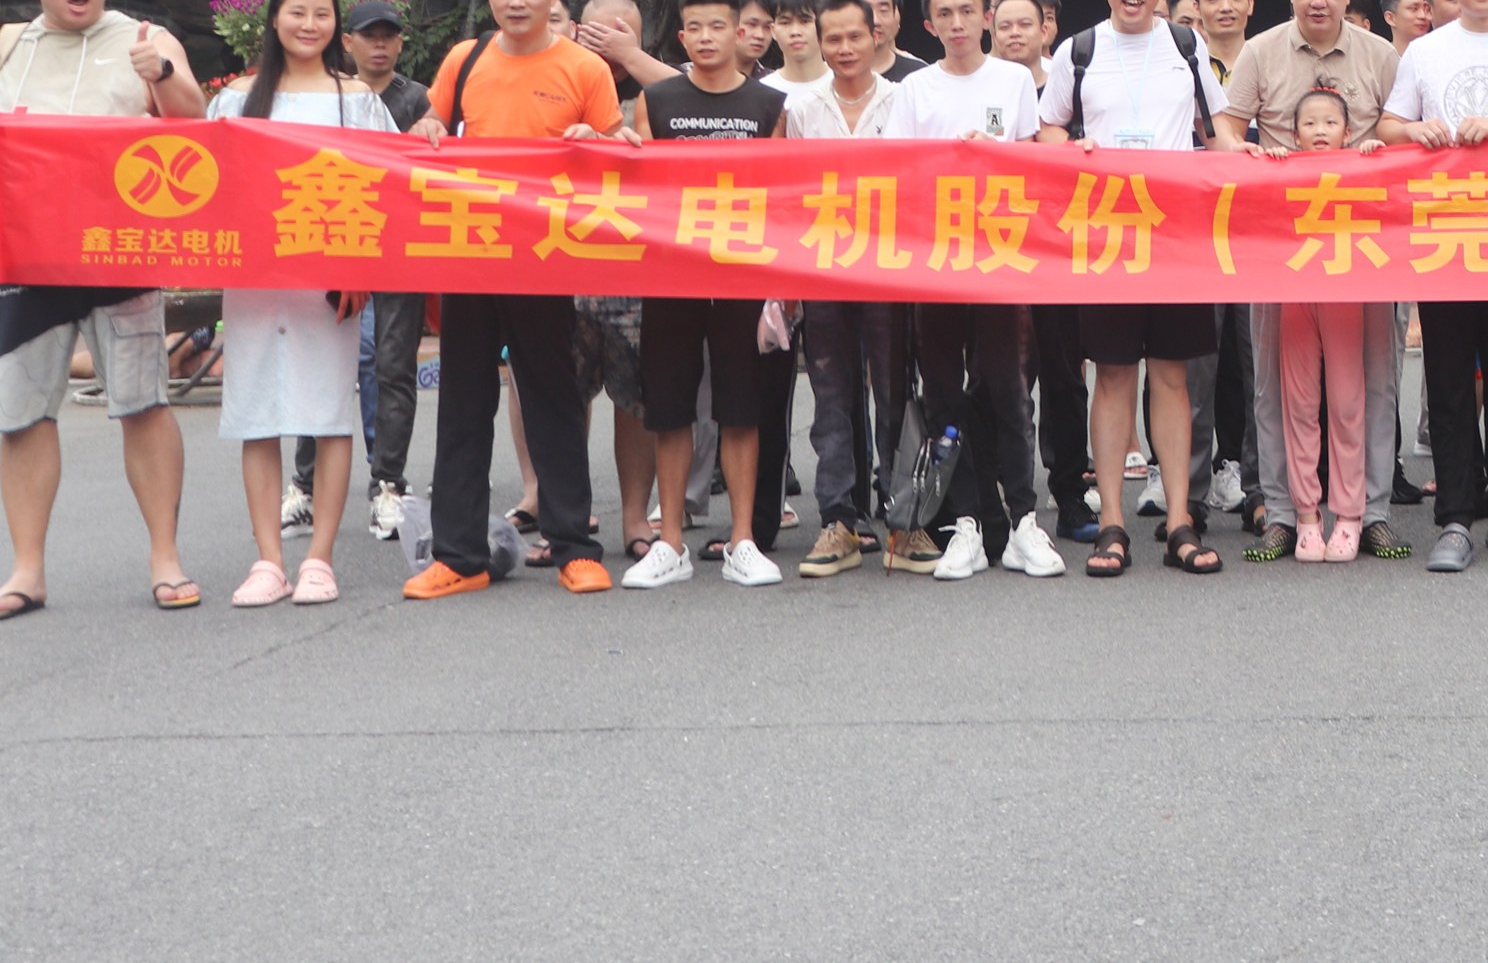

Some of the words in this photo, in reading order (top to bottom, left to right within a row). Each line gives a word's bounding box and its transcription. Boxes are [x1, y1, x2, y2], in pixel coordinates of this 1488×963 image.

[669, 117, 759, 132] COMMUNICATION
[81, 226, 243, 255] 鑫宝达电机
[80, 254, 158, 265] SINBAD
[171, 256, 242, 267] MOTOR
